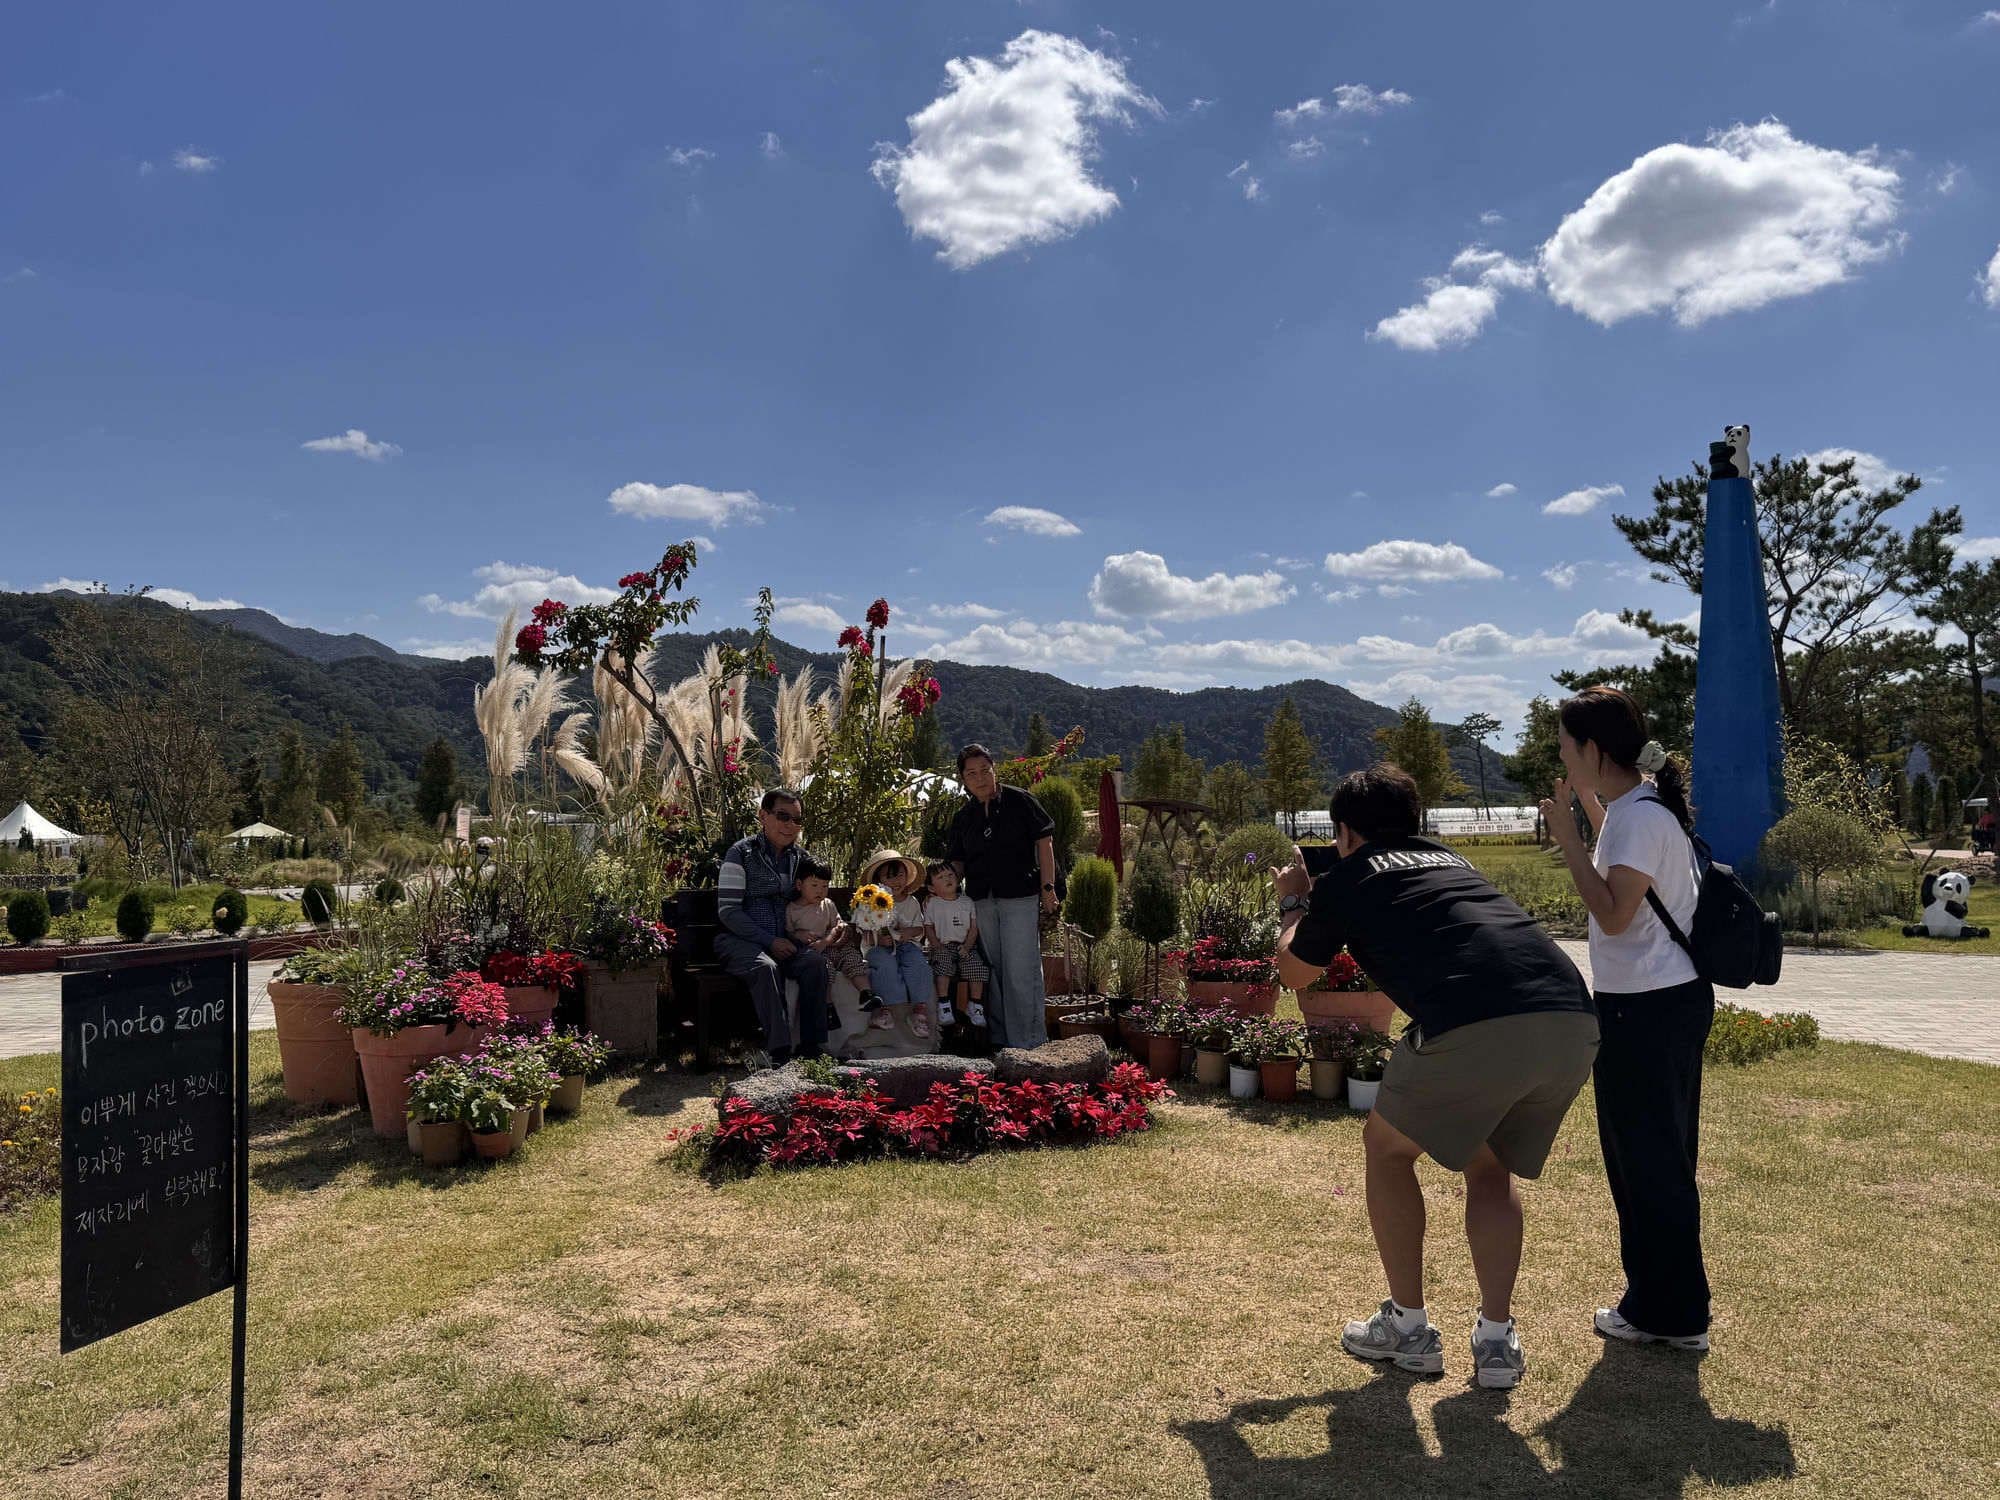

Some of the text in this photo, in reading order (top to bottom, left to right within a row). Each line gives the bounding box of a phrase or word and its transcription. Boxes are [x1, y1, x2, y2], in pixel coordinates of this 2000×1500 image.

[81, 999, 225, 1069] photo zone
[145, 1079, 177, 1109] 사진
[74, 1190, 150, 1234] 제자리에
